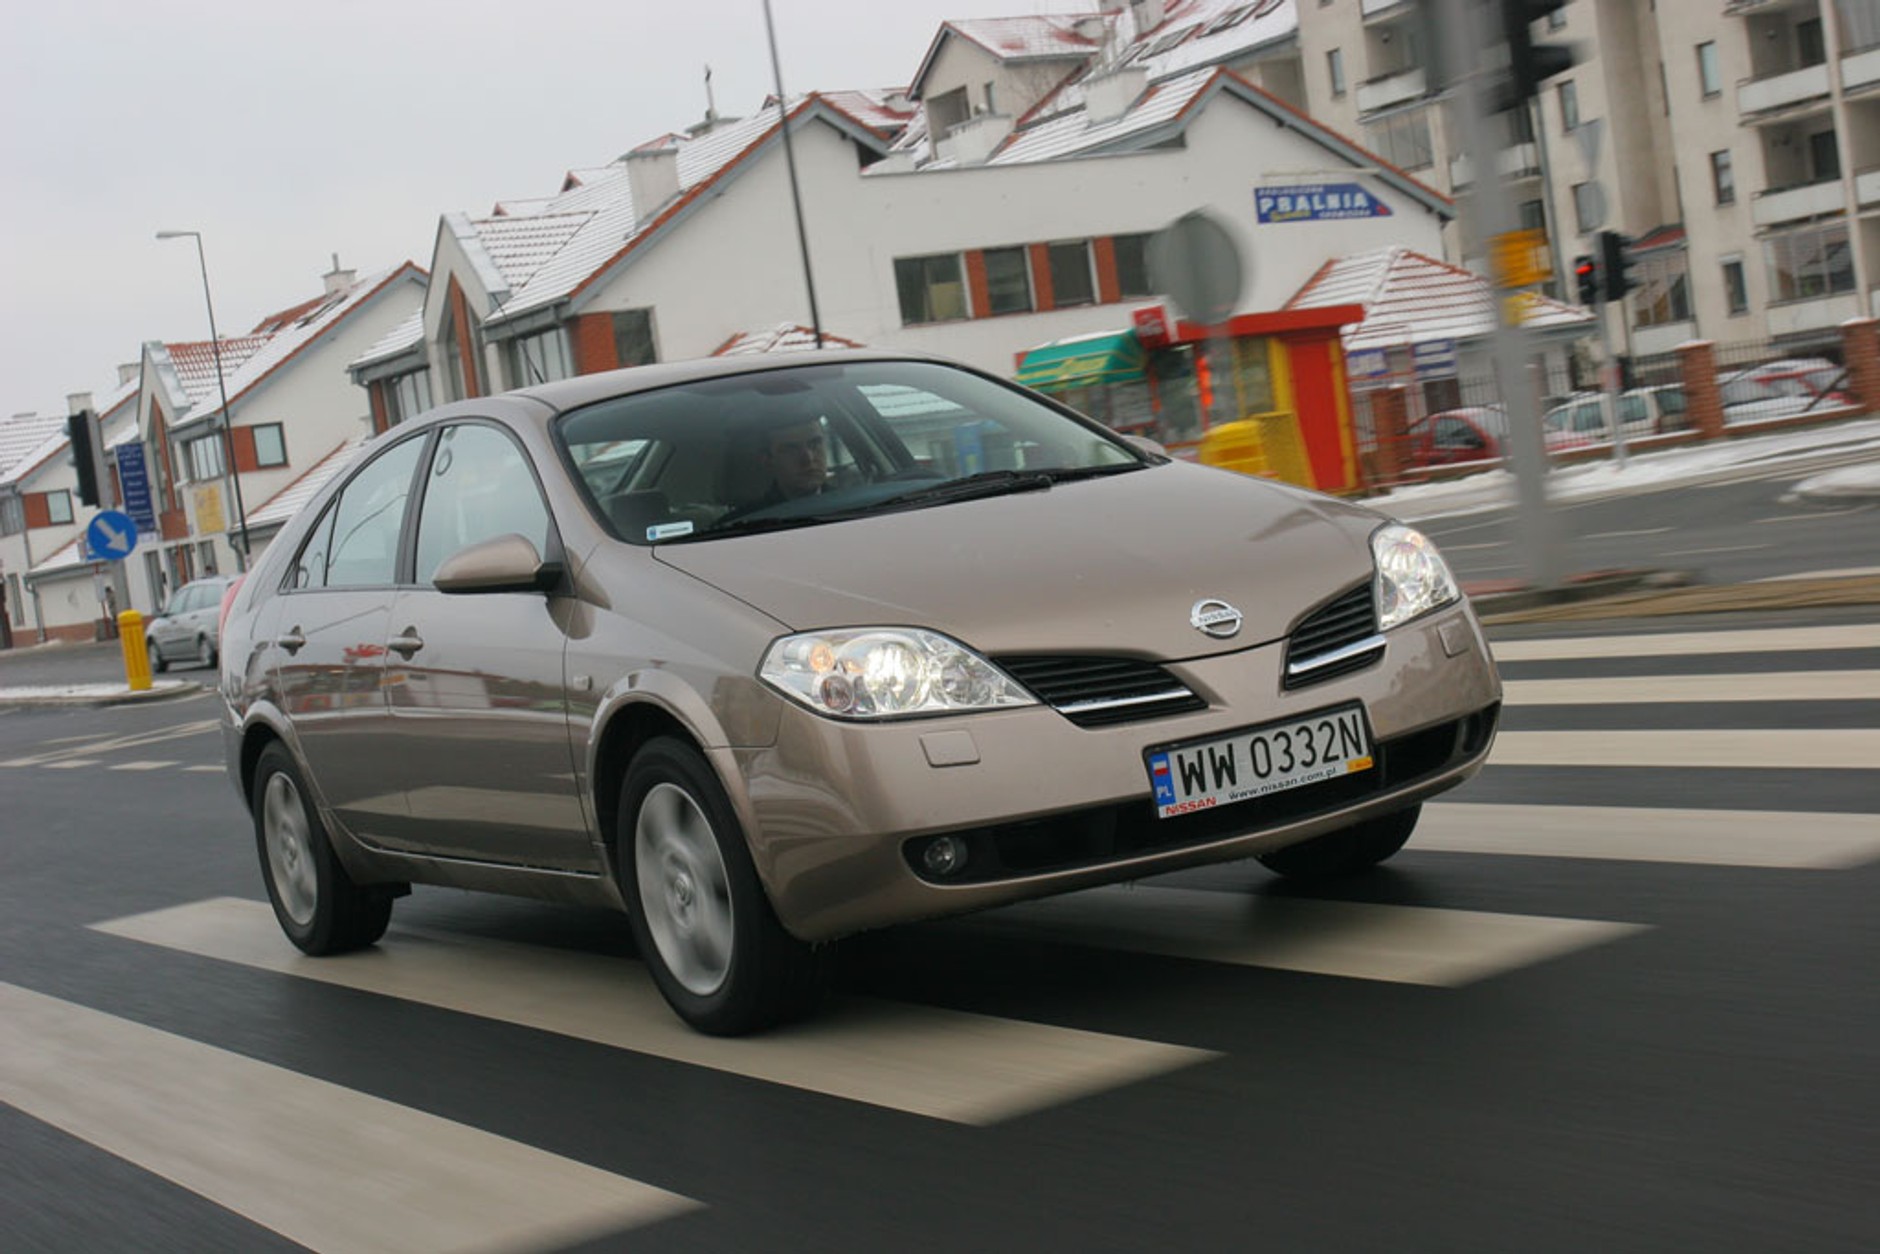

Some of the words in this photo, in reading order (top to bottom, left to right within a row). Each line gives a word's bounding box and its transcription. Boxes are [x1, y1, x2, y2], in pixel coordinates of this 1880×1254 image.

[1177, 743, 1237, 796] WW
[1250, 713, 1363, 779] 0332N
[1157, 785, 1172, 799] PL
[1228, 767, 1337, 800] www.nissan.com.pl
[1165, 796, 1217, 816] NISSAN
